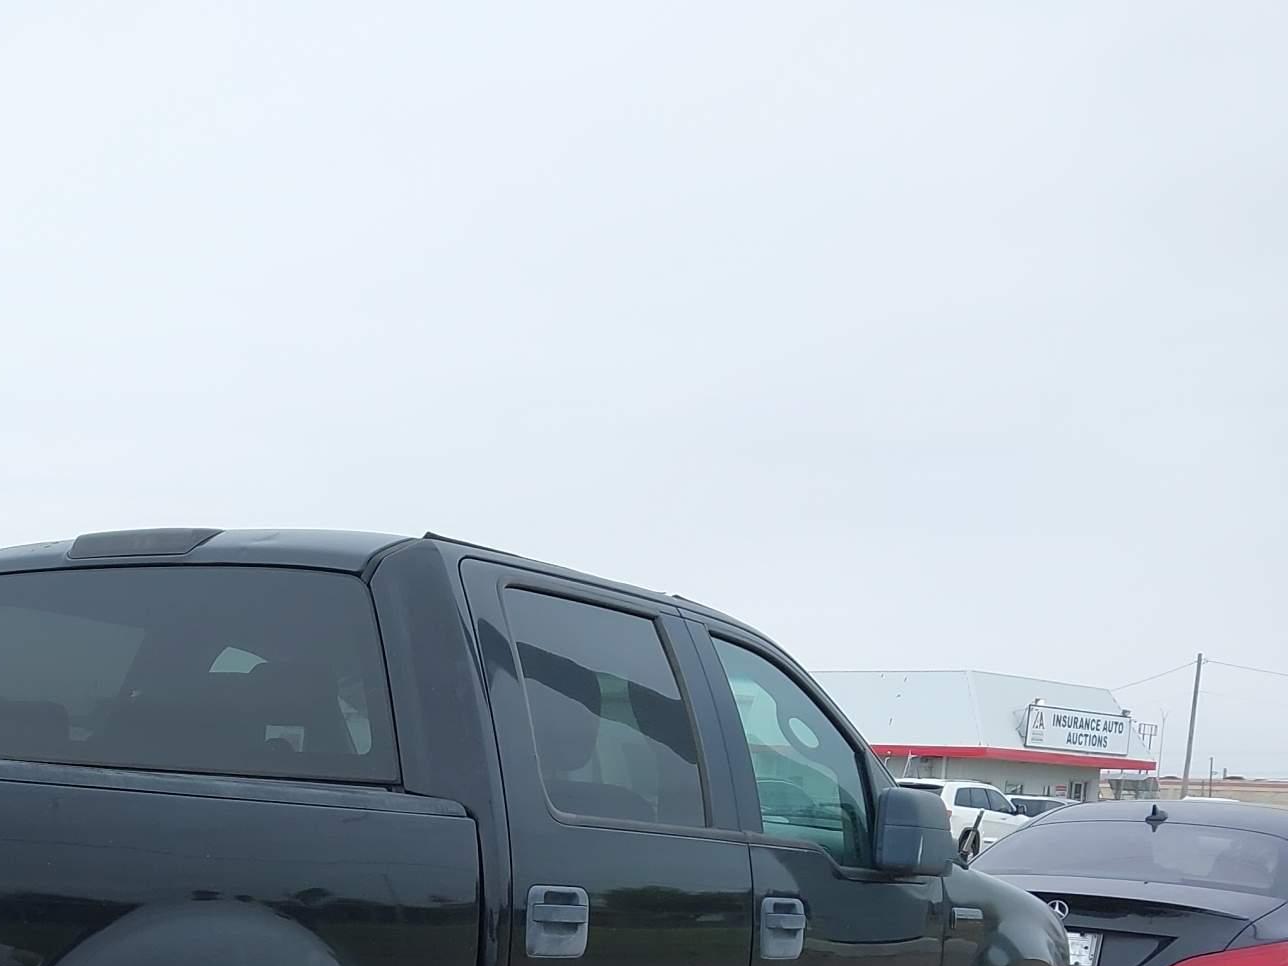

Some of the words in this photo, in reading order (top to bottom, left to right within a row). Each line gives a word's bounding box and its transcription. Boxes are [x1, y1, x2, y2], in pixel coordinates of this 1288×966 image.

[1052, 713, 1100, 732] INSURANCE
[1102, 719, 1124, 734] AUTO
[1066, 732, 1108, 748] AUCTIONS
